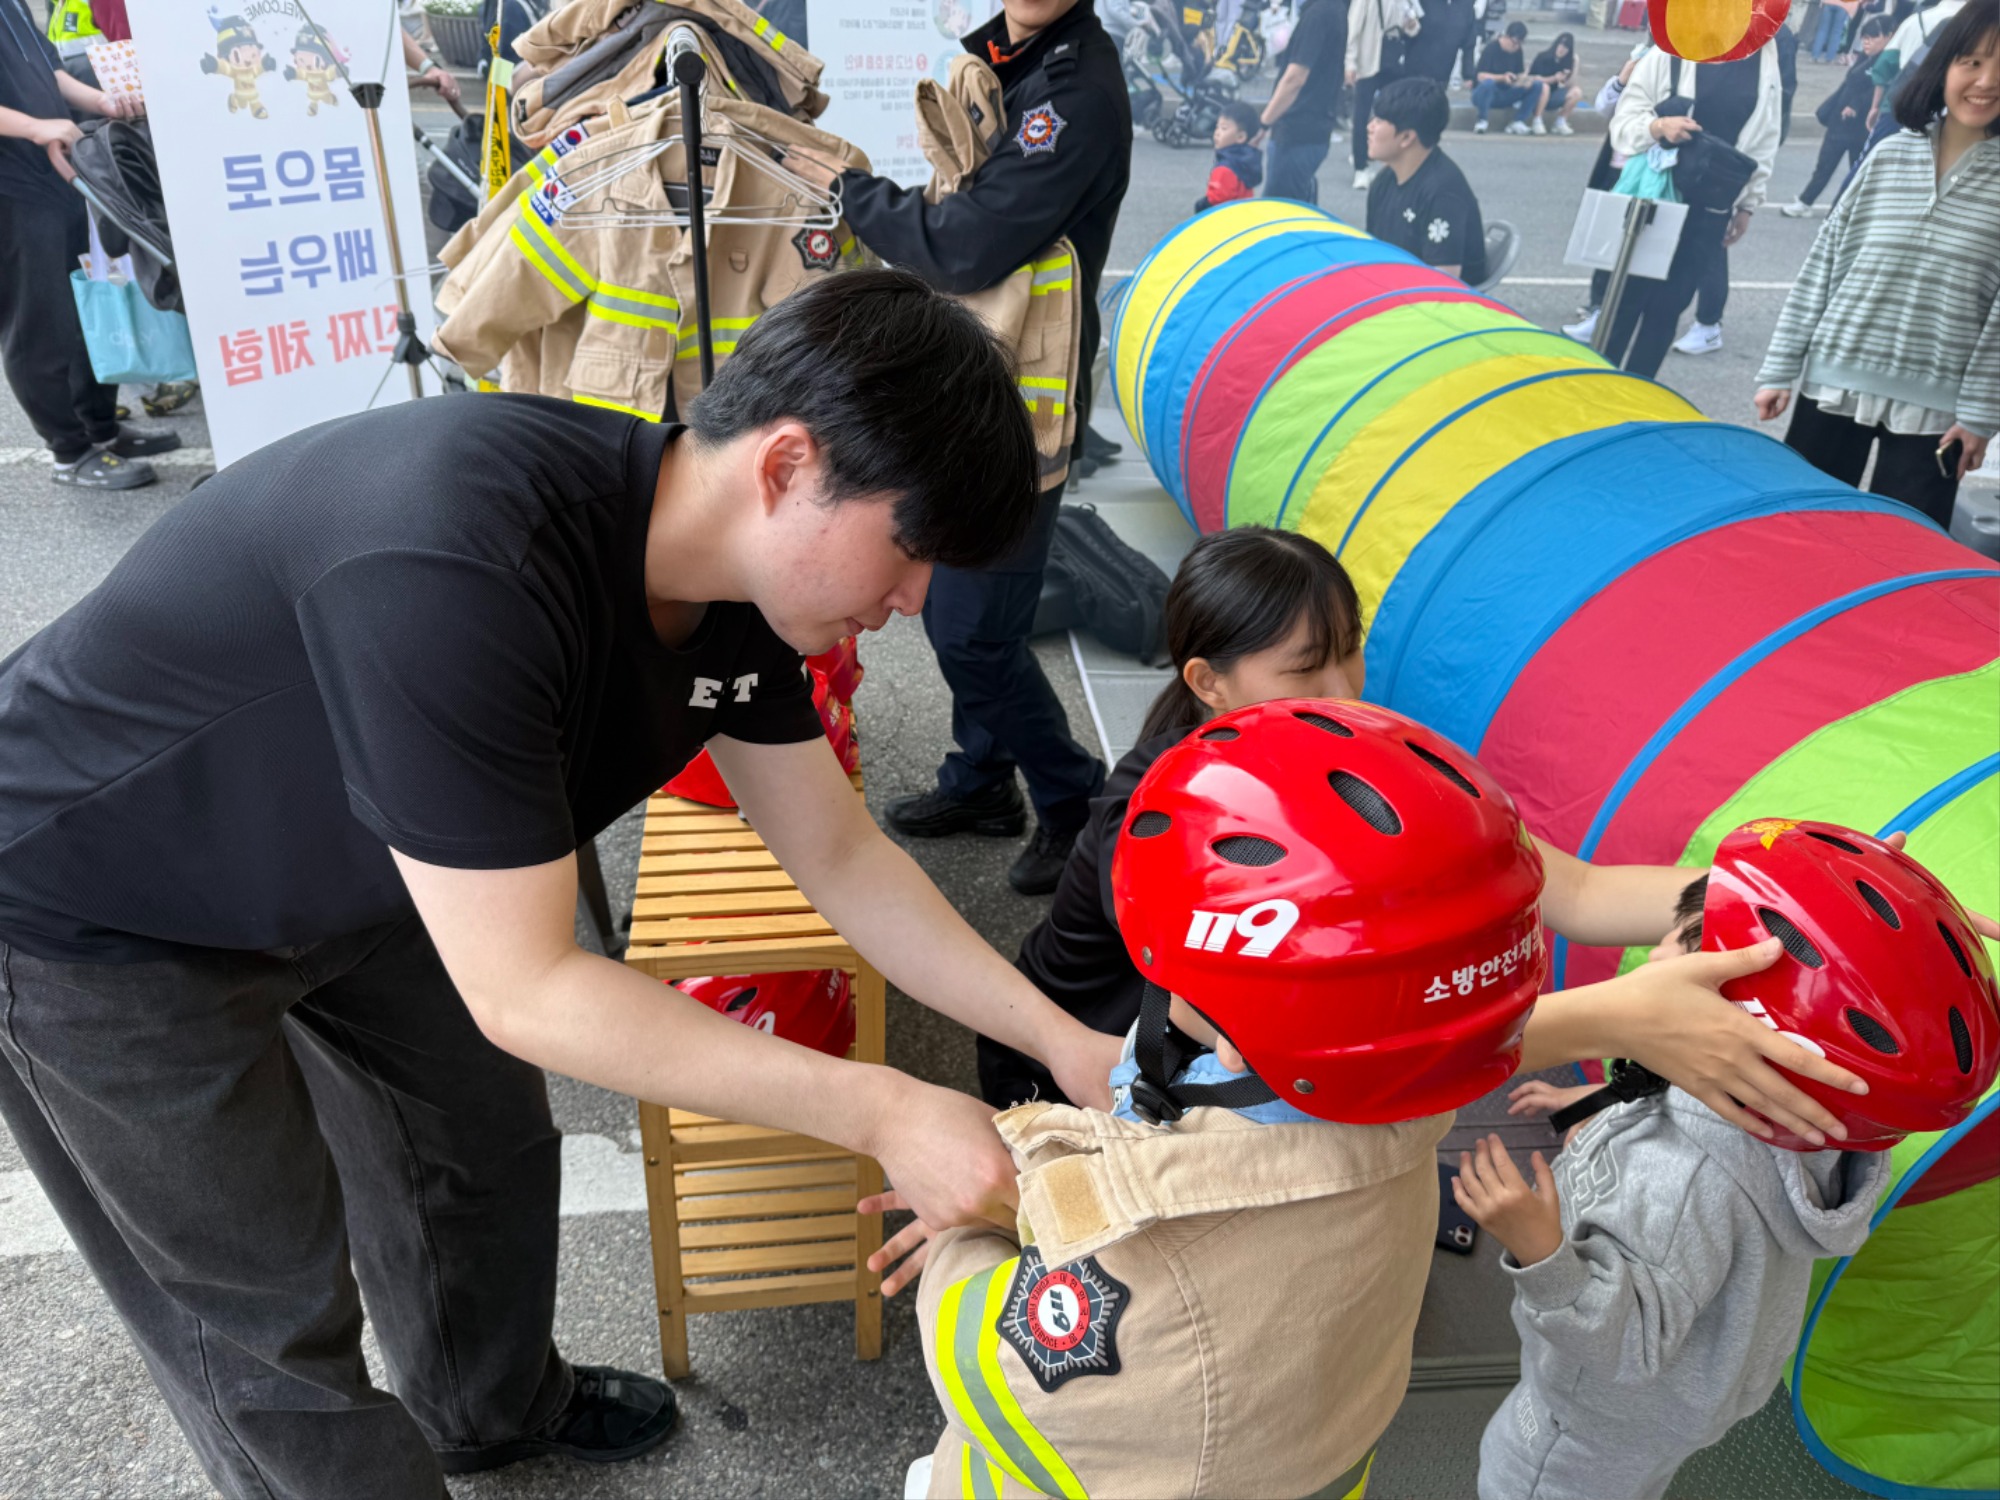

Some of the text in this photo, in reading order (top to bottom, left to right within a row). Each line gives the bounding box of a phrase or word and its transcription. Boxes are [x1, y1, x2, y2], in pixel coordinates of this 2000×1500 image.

[688, 673, 759, 709] ET
[1184, 898, 1300, 958] 119
[1049, 1289, 1071, 1333] 119
